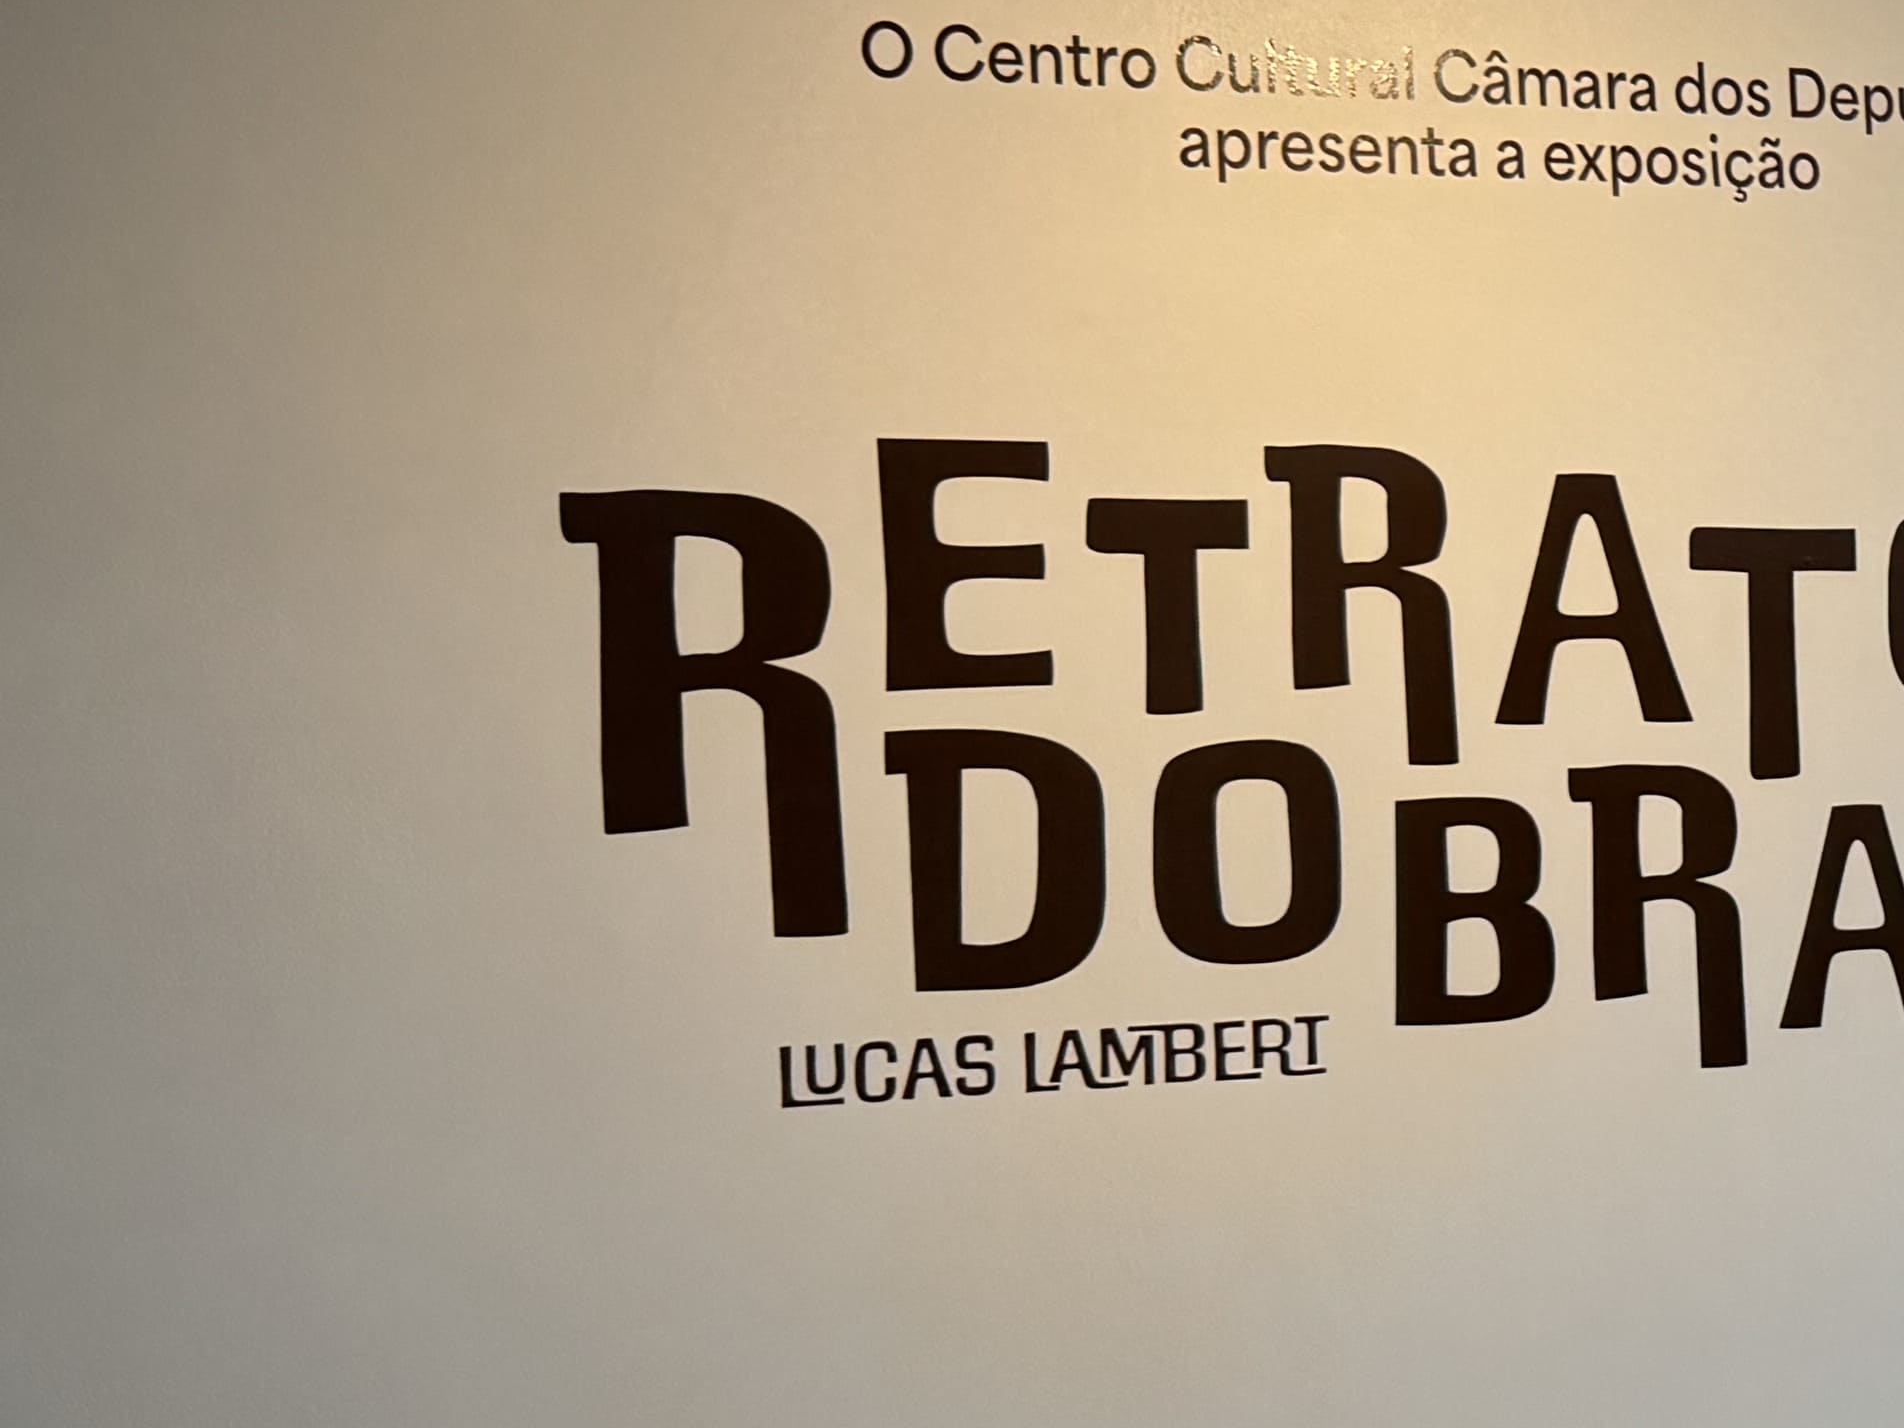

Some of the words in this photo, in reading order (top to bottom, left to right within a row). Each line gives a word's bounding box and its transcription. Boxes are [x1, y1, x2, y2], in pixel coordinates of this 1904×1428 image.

[861, 21, 913, 78] O
[934, 24, 1156, 89] Centro
[1176, 35, 1415, 101] Cultural
[1434, 49, 1657, 111] Câmara
[1675, 61, 1771, 117] dos
[1180, 126, 1477, 183] apresenta
[1497, 140, 1525, 179] a
[1544, 133, 1820, 203] exposição
[780, 1036, 994, 1108] LUCAS
[1025, 1016, 1328, 1092] LAMBERT
